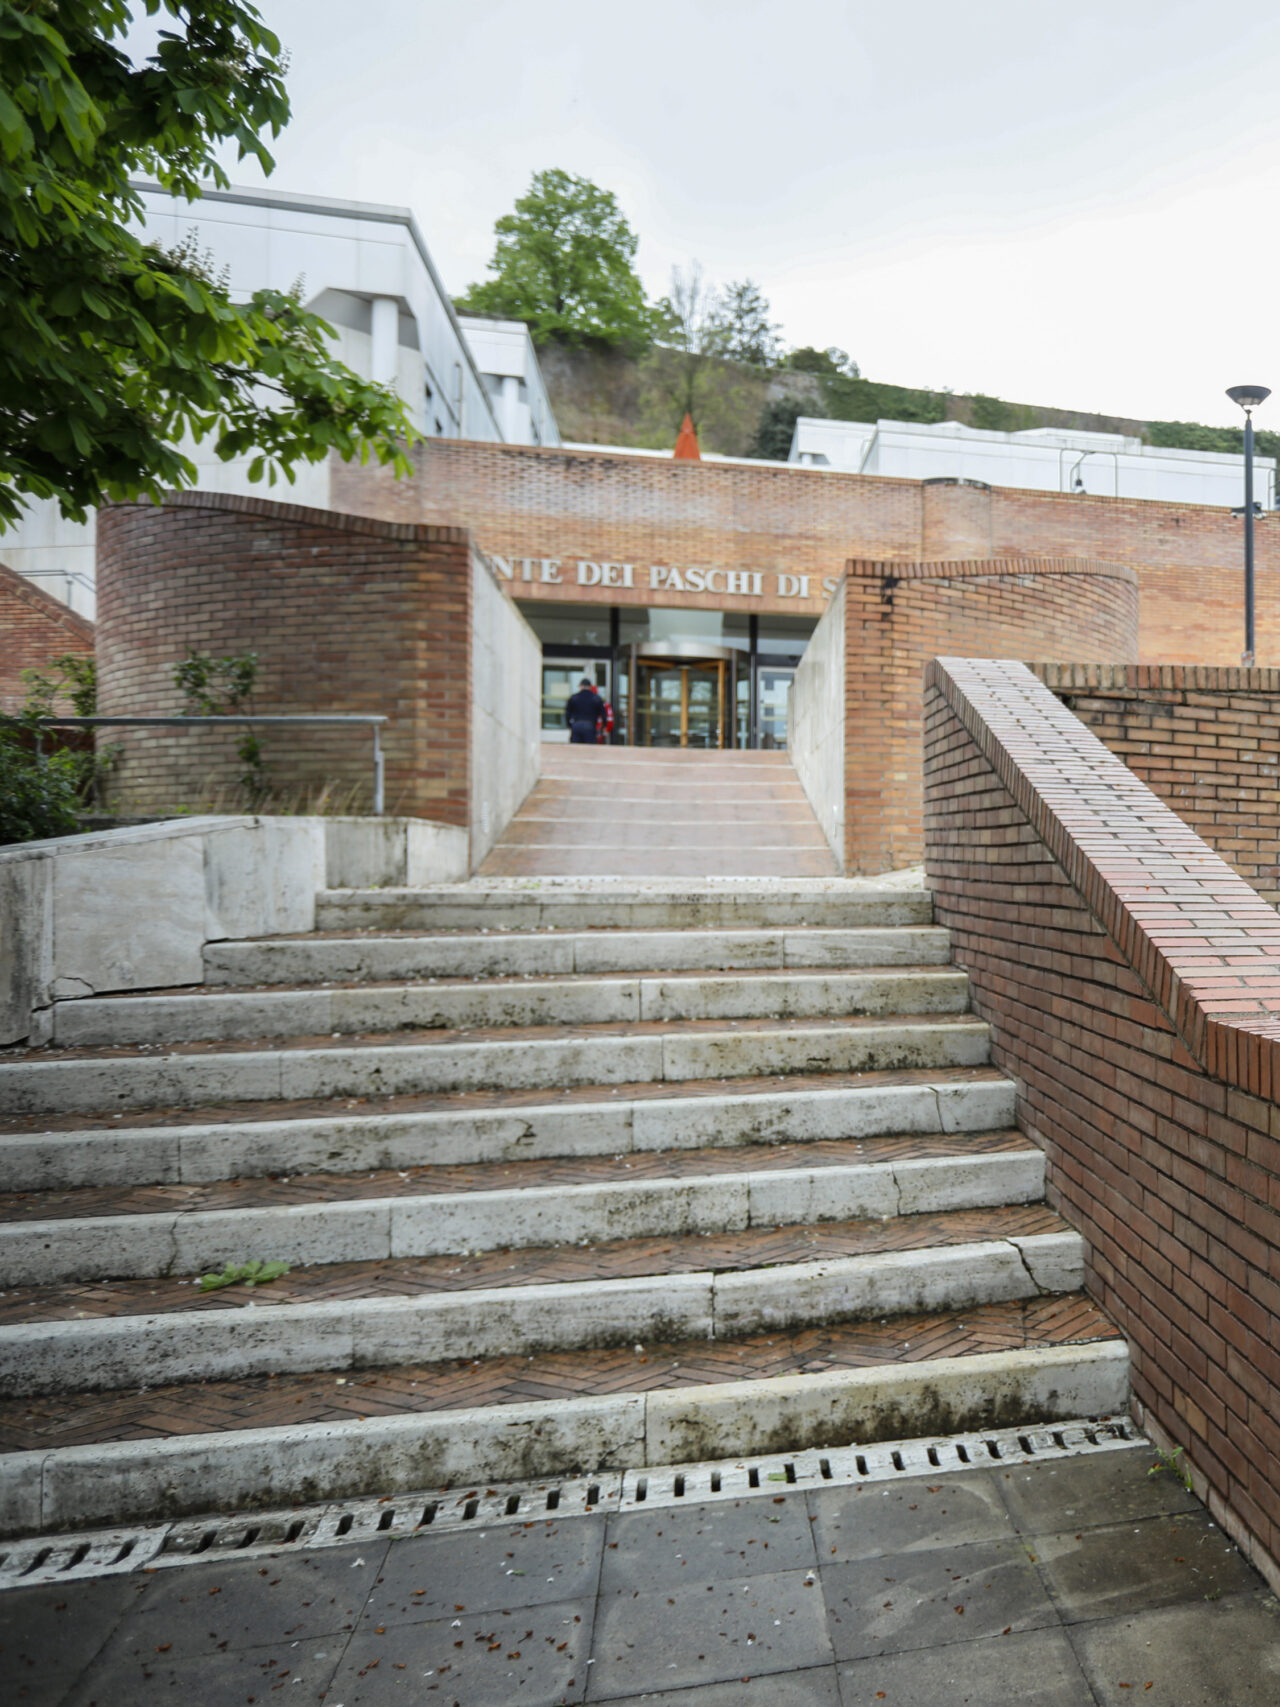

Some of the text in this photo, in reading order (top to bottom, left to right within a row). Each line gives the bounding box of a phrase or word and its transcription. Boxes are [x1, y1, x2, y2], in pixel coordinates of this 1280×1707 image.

[484, 556, 841, 600] NTE DEI PASCHI DI S
